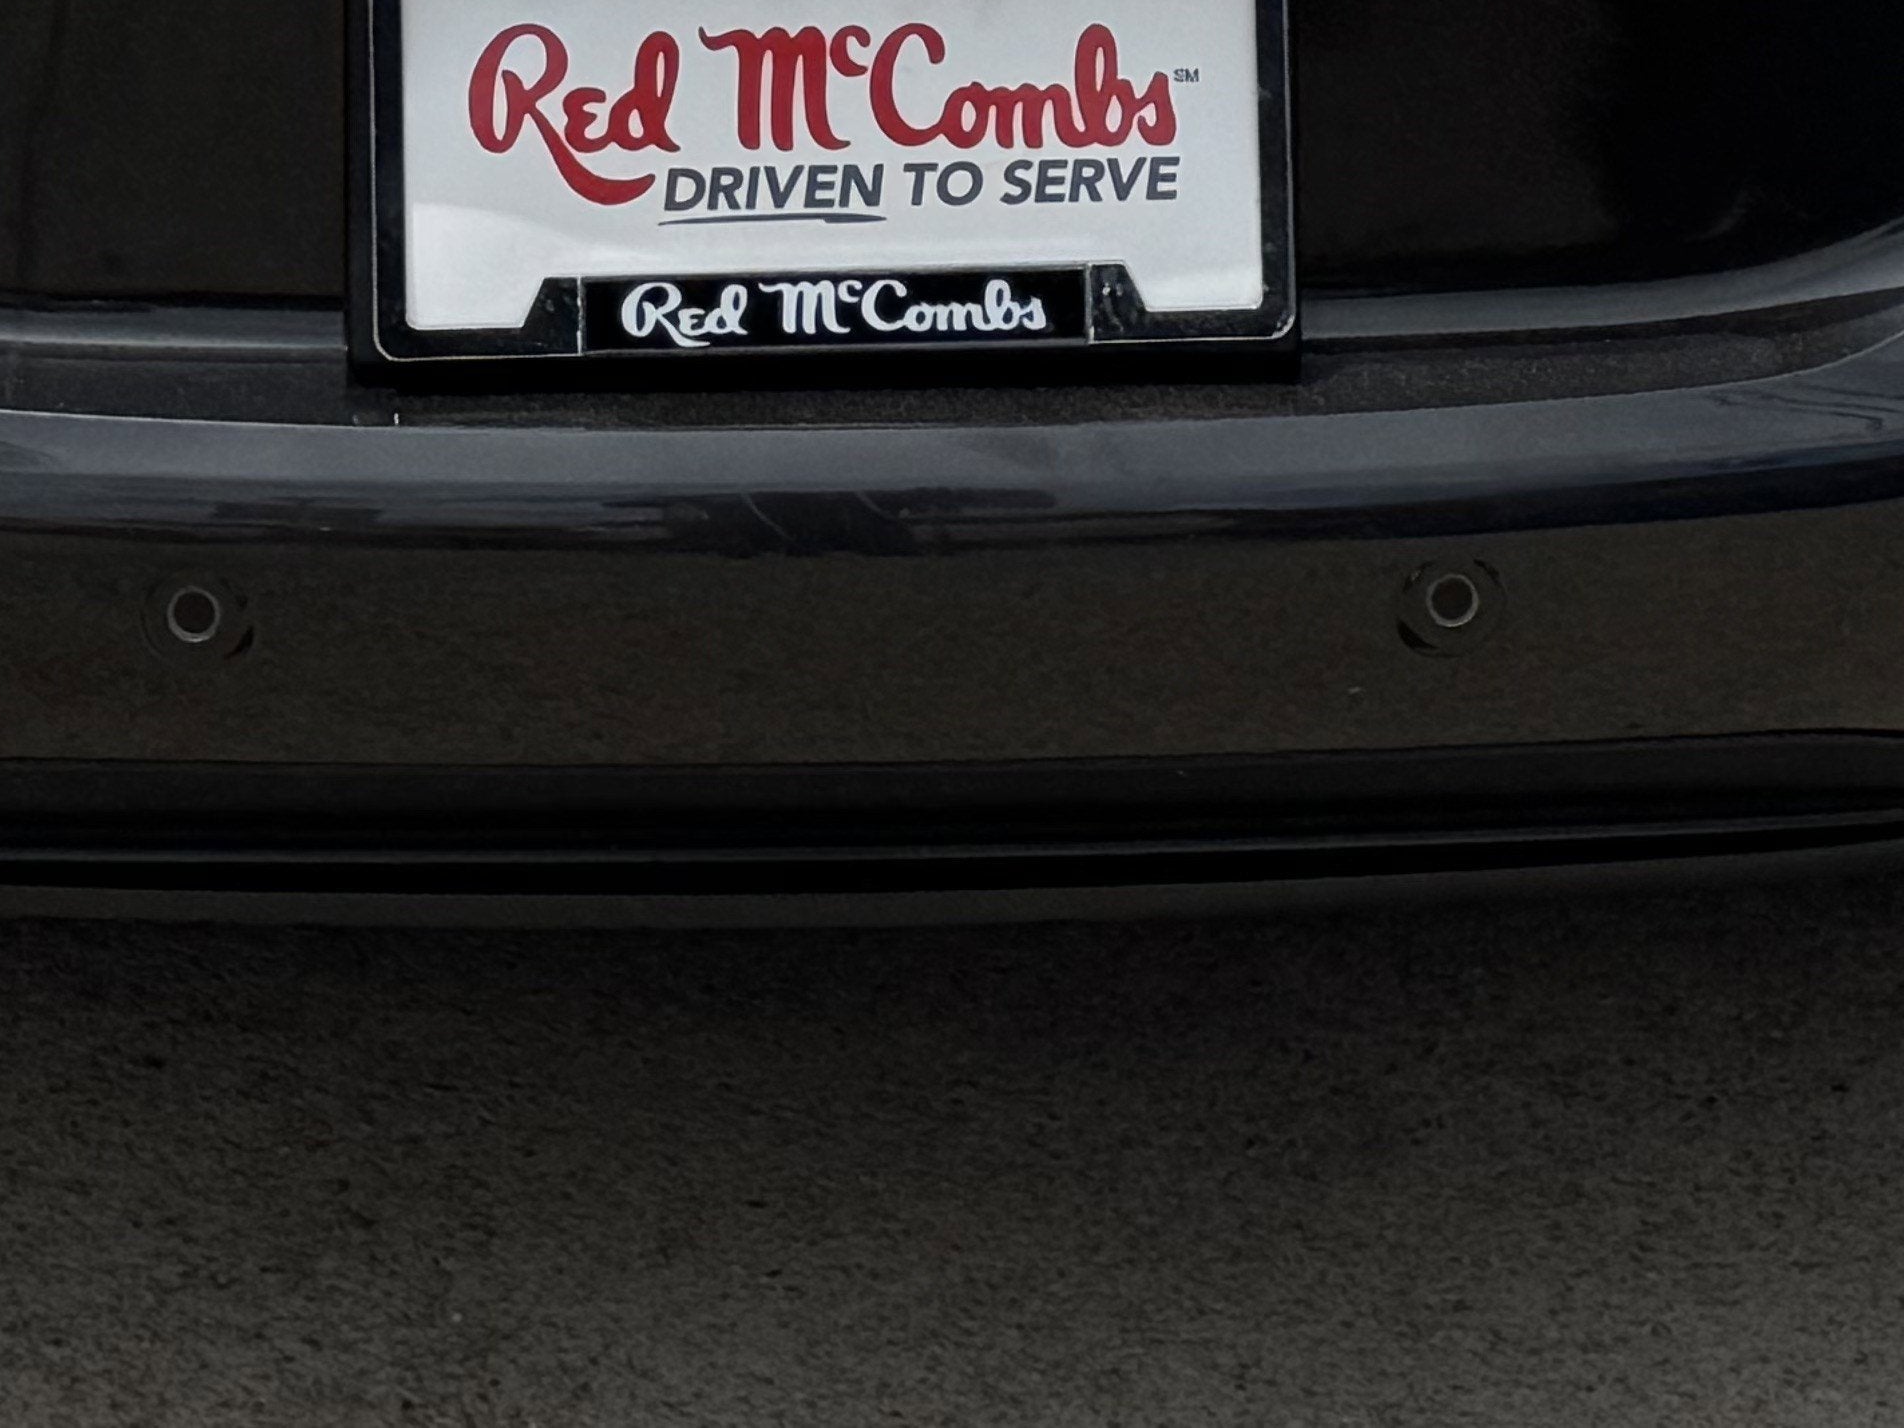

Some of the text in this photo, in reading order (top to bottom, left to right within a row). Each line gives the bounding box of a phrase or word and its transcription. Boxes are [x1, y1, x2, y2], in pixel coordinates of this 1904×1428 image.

[467, 21, 680, 204] Red
[698, 21, 1179, 151] McCombs
[663, 155, 1181, 213] DRIVEN TO SERVE
[621, 278, 1048, 348] Red McCombs
